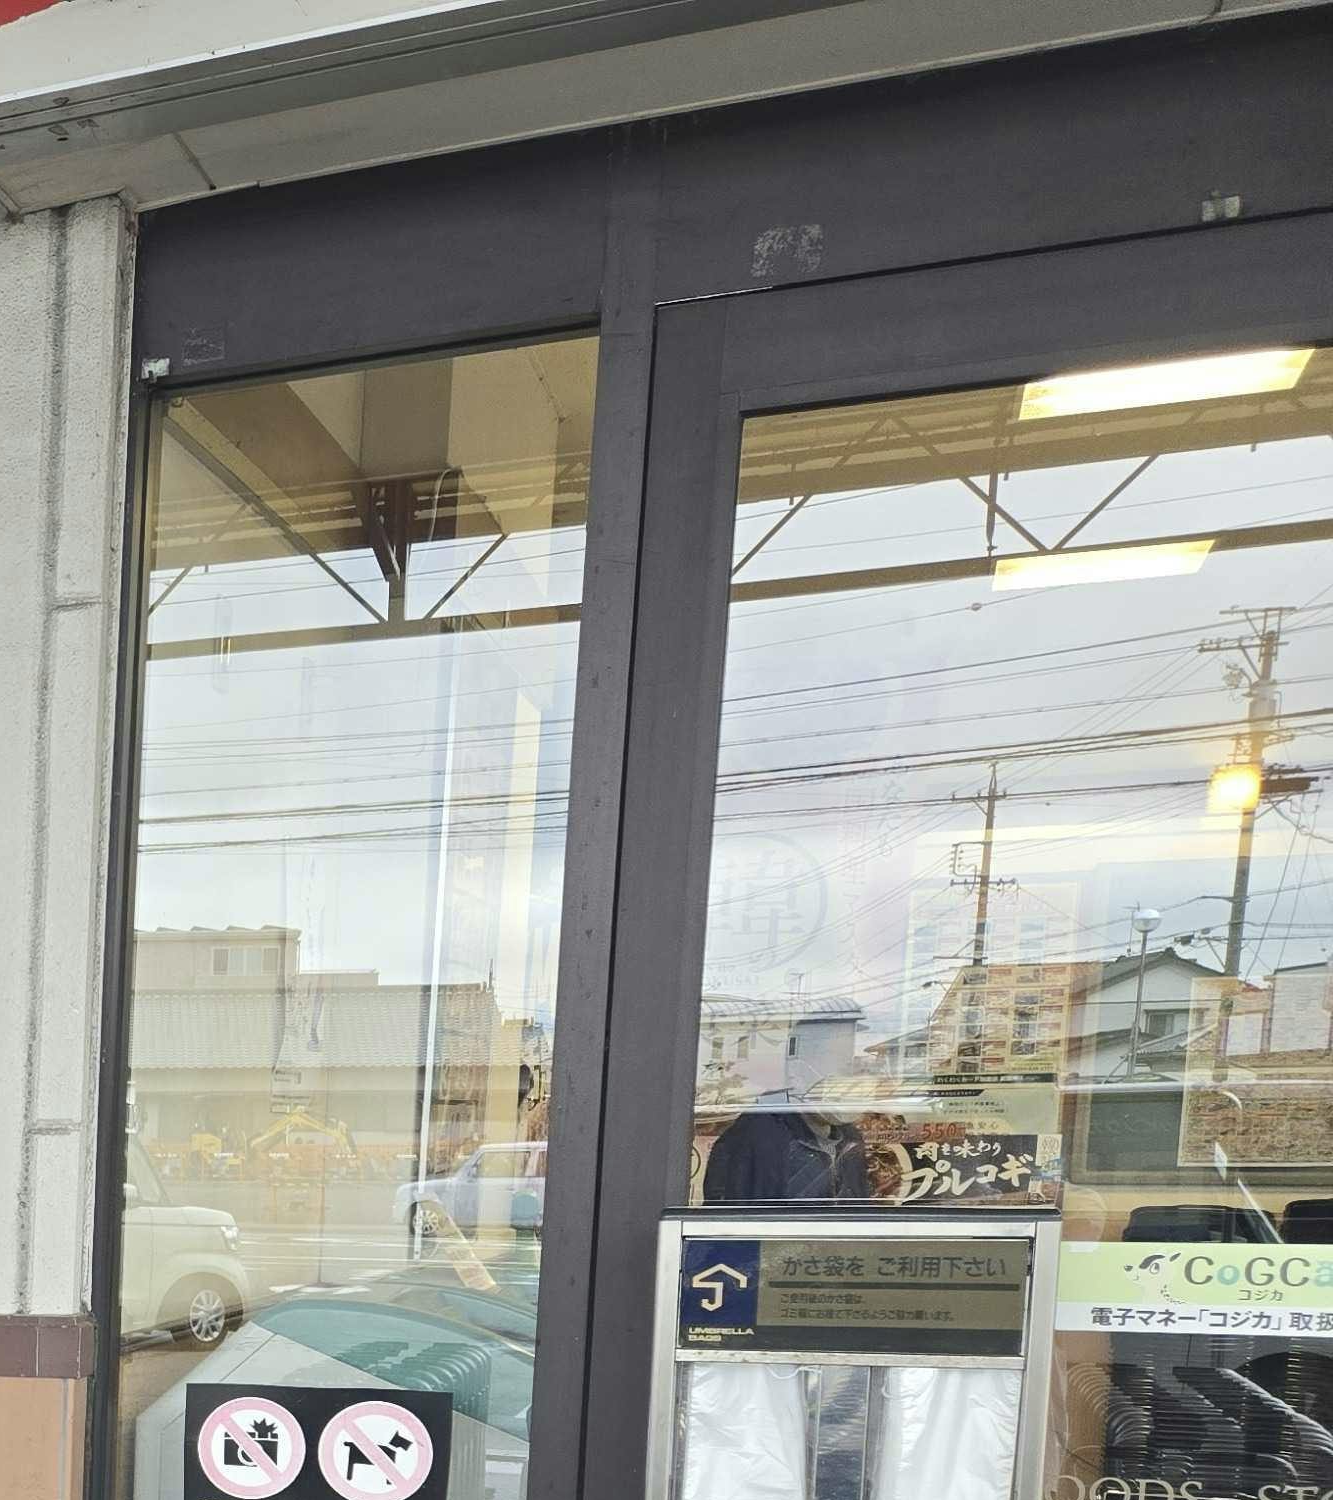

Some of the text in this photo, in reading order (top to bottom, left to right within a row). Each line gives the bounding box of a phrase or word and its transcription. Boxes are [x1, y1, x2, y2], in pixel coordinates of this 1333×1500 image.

[781, 1255, 1007, 1278] かさ袋を ご利用下さい
[1237, 1288, 1283, 1303] コジカ
[688, 1327, 755, 1335] UMBRELLA
